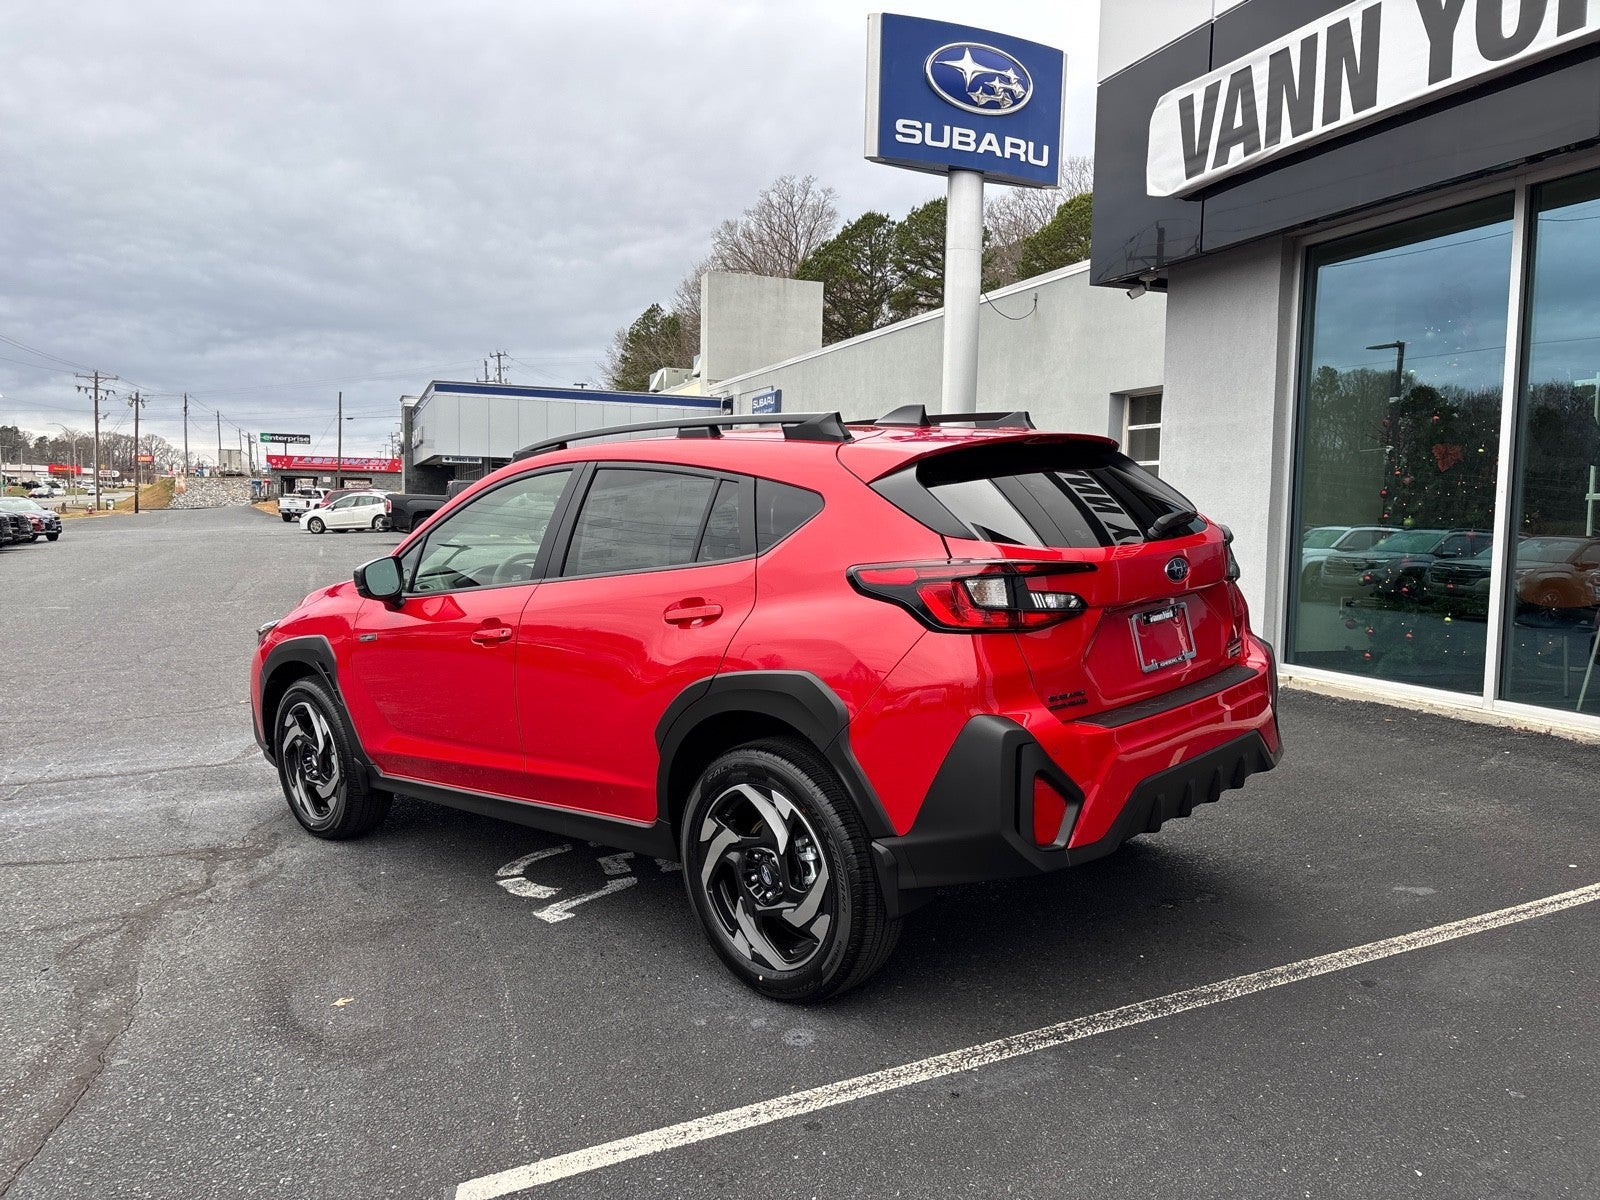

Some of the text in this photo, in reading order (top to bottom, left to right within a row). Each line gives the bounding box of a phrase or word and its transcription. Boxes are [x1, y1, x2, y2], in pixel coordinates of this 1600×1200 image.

[1178, 0, 1588, 181] VANN YO
[895, 118, 1050, 168] SUBARU
[753, 395, 775, 409] SUBARU
[263, 433, 310, 443] enterprise
